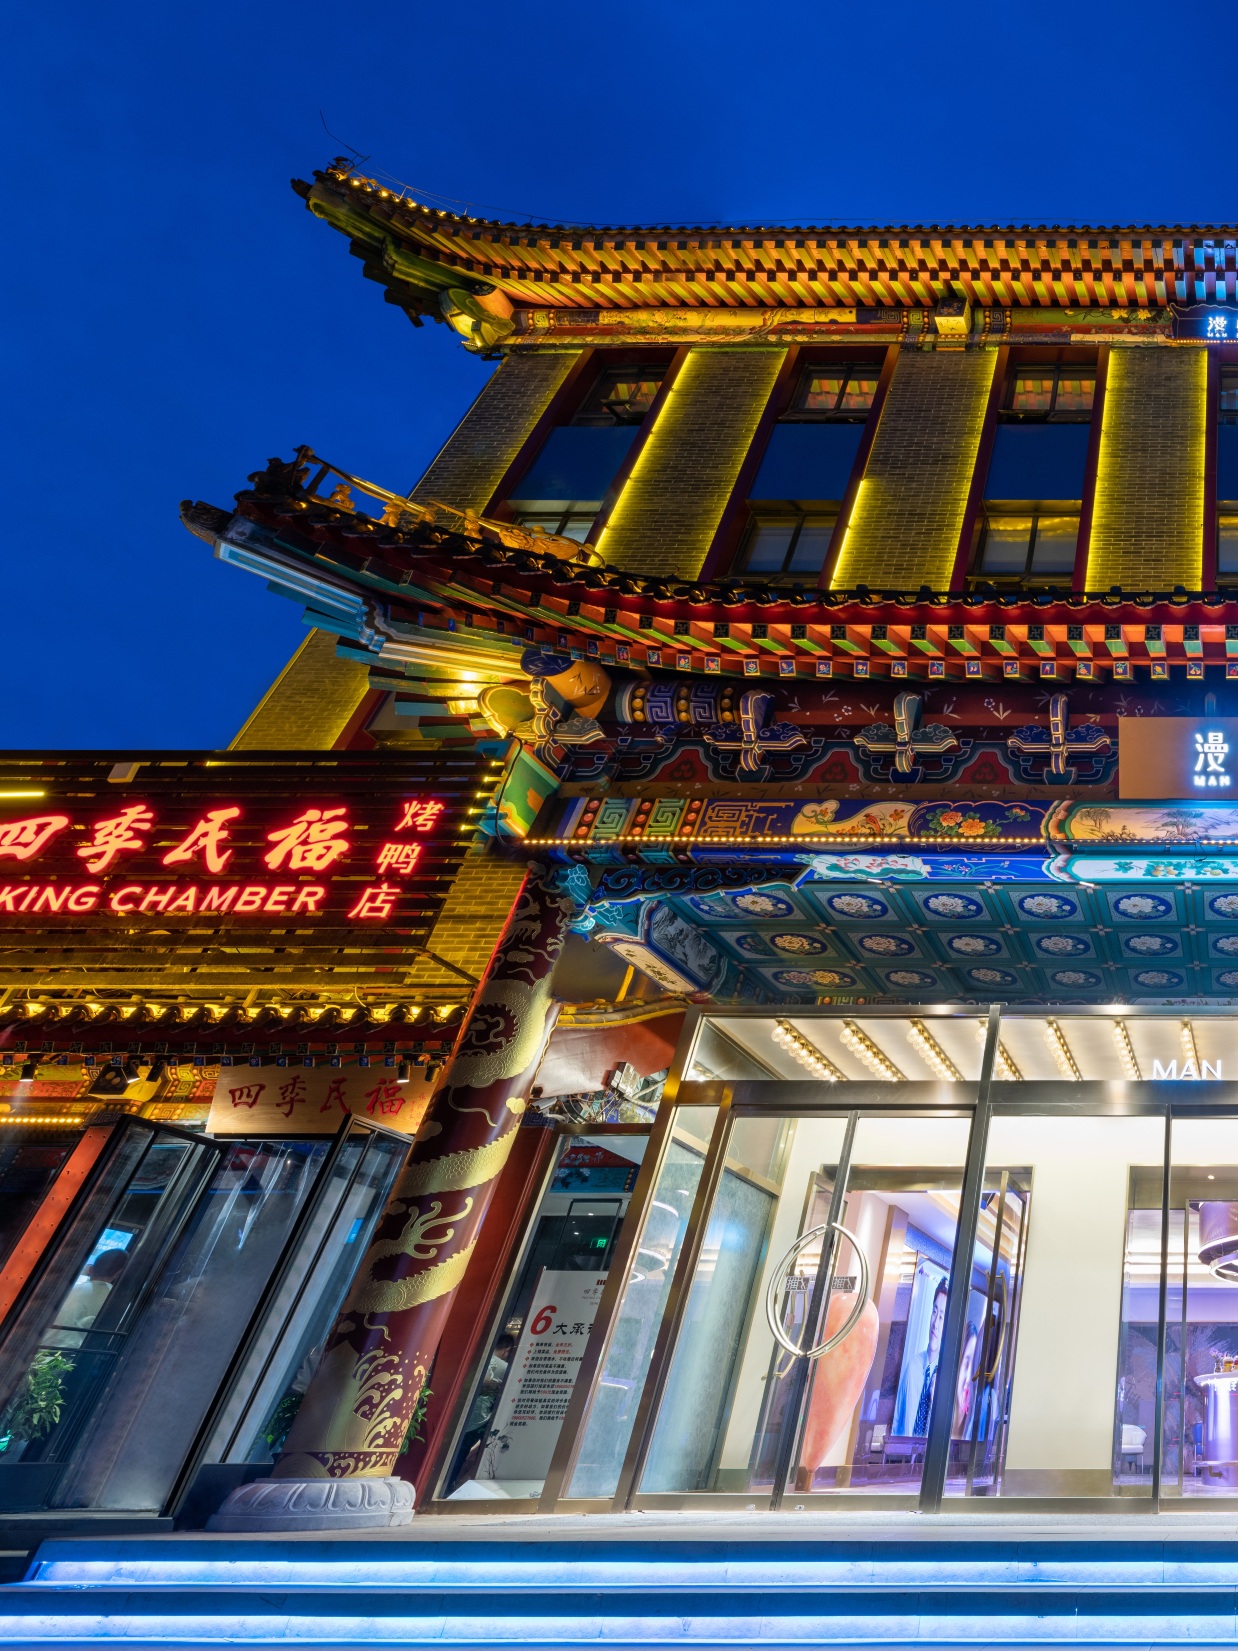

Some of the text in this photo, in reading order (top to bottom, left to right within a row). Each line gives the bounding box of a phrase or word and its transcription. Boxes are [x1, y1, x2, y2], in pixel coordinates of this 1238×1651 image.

[1194, 775, 1230, 787] MAN
[0, 804, 350, 875] 四季民福
[348, 800, 444, 919] 烤鸭店
[110, 886, 325, 912] CHAMBER
[1152, 1059, 1222, 1080] MAN
[228, 1074, 406, 1118] 四季民福
